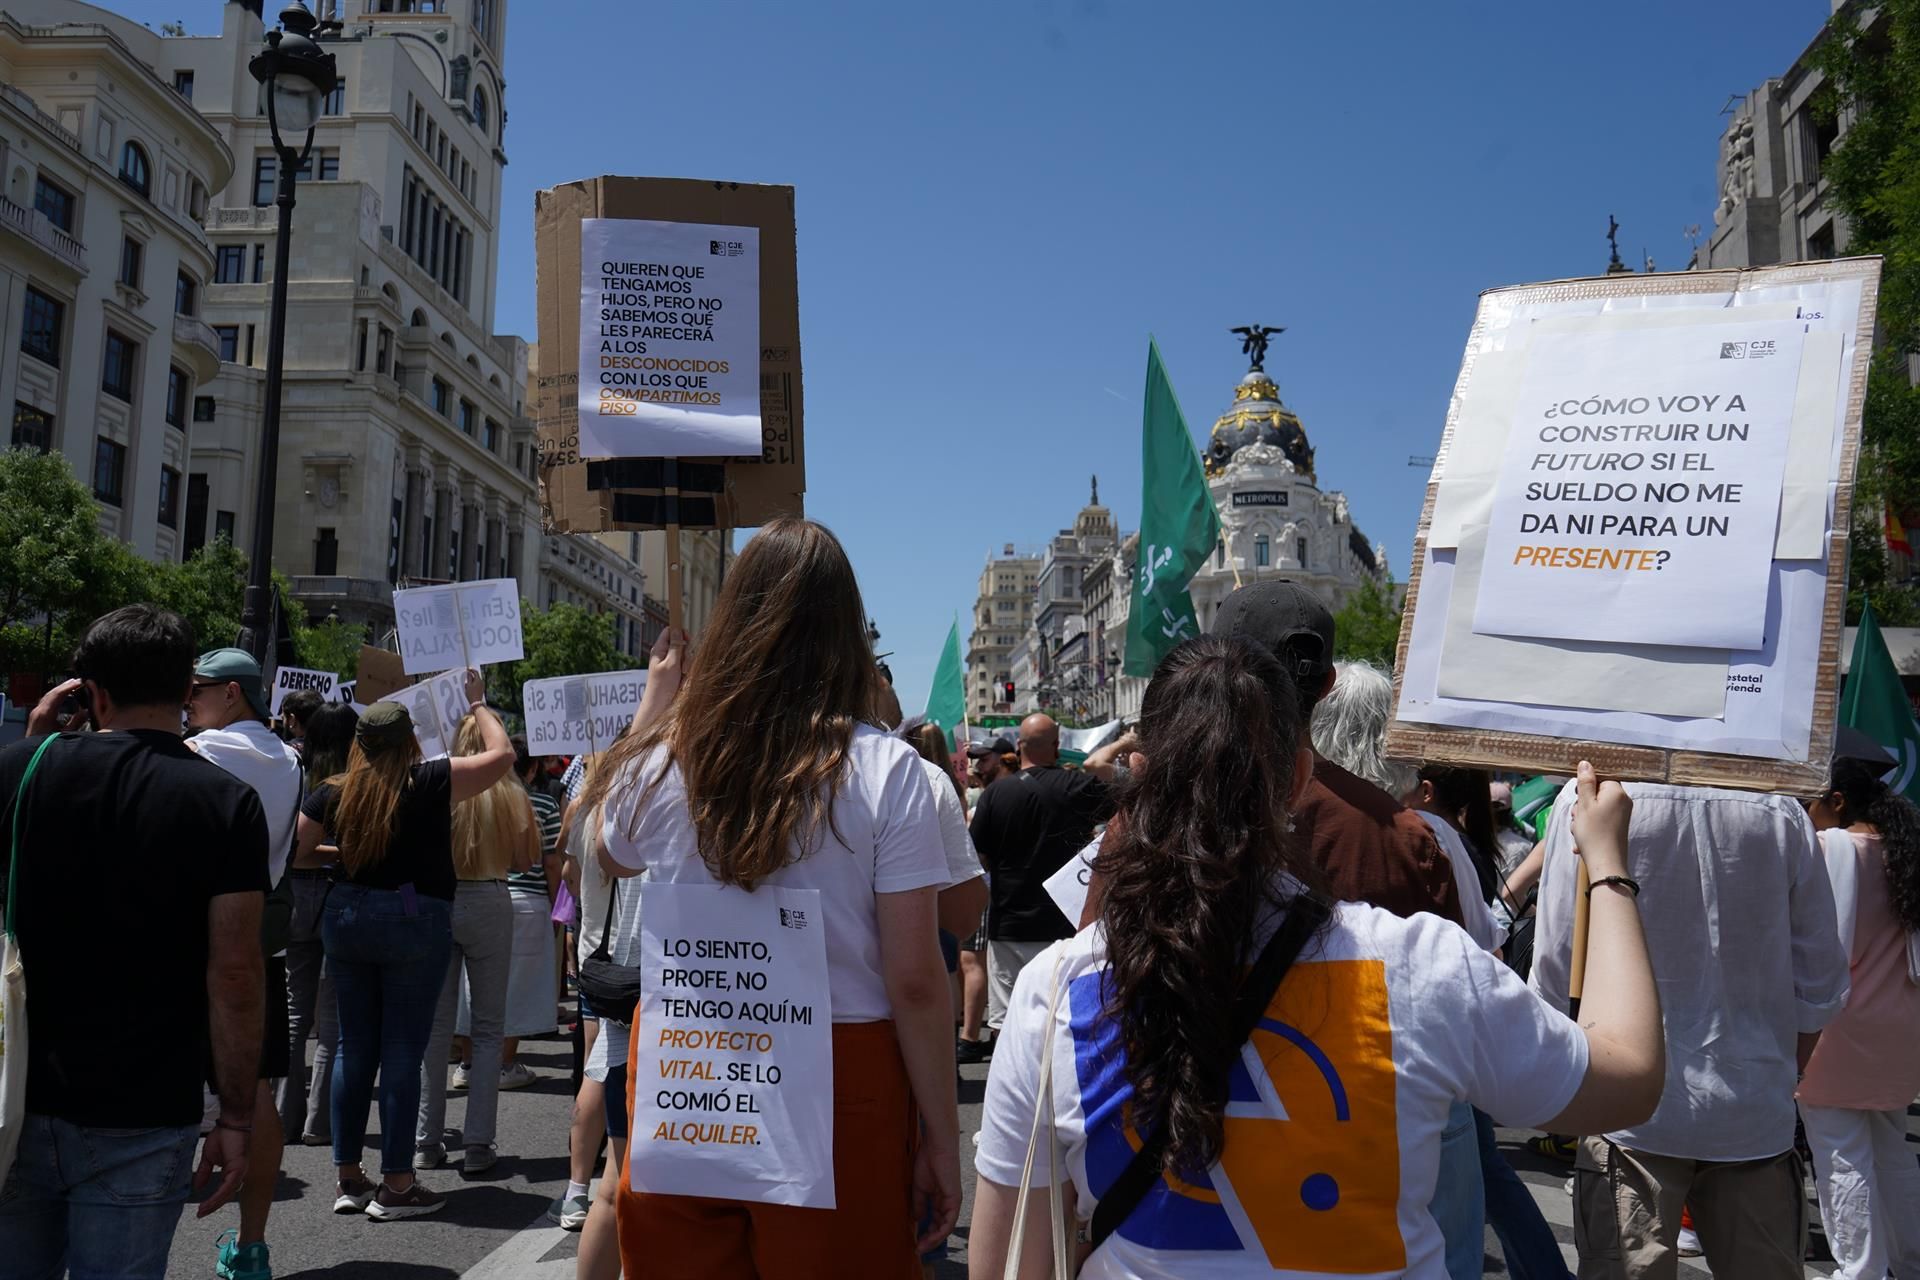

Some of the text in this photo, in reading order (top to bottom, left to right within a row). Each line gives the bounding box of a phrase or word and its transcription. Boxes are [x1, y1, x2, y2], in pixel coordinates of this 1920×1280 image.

[602, 262, 704, 279] QUIEREN QUE
[601, 278, 691, 293] TENGAMOS
[602, 294, 722, 311] HIJOS, PERO NO
[601, 309, 713, 327] SABEMOS QUÉ
[601, 325, 713, 341] LES PARECERÁ
[601, 341, 646, 354] A LOS
[1751, 341, 1775, 349] CJE
[601, 357, 728, 374] DESCONOCIDOS
[600, 373, 707, 389] CON LOS QUE
[600, 388, 720, 405] COMPARTIMOS
[599, 402, 636, 416] PISO
[1544, 395, 1745, 418] ¿CÓMO VOY A
[1540, 424, 1749, 442] CONSTRUIR UN
[1531, 453, 1714, 471] FUTURO SI EL
[1234, 494, 1286, 505] METROPOLIS
[1526, 482, 1743, 502] SUELDO NO ME
[1520, 514, 1729, 536] DA NI PARA UN
[1514, 546, 1671, 570] PRESENTE?
[280, 670, 332, 694] DERECHO
[664, 939, 771, 963] LO SIENTO,
[663, 969, 767, 991] PROFE, NO
[662, 999, 811, 1025] TENGO AQUÍ MI
[660, 1029, 772, 1052] PROYECTO
[659, 1060, 781, 1084] VITAL. SE LO
[657, 1089, 760, 1113] COMIÓ EL
[654, 1122, 760, 1145] ALQUILER.
